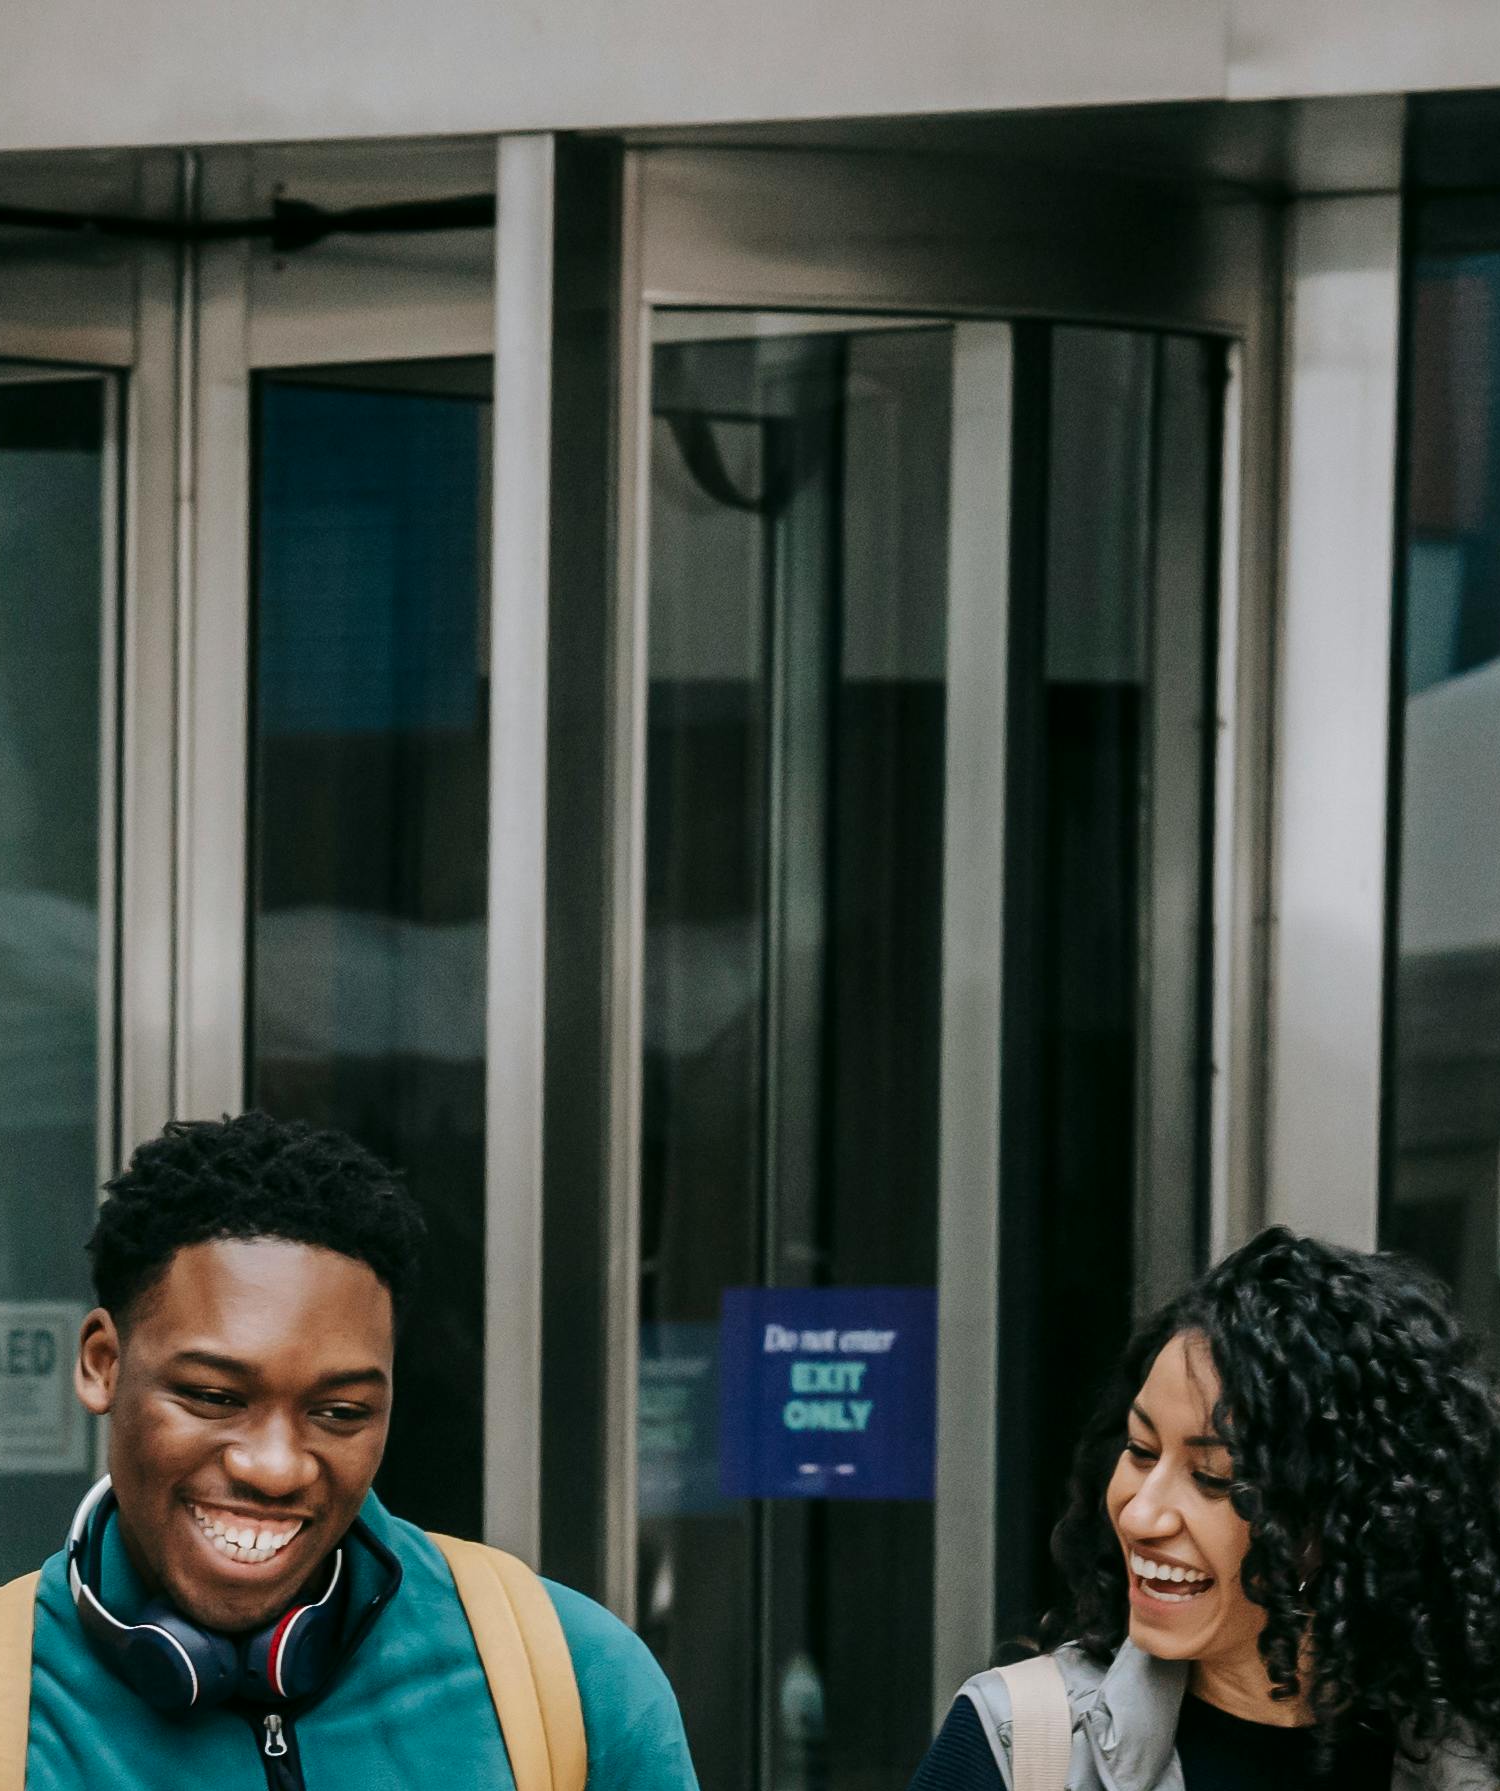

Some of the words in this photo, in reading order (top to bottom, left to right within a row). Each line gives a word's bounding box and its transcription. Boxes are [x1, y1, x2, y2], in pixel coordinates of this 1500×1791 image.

[764, 1323, 797, 1353] Do
[799, 1329, 836, 1353] not
[838, 1329, 897, 1353] enter
[791, 1361, 867, 1394] EXIT
[783, 1399, 873, 1431] ONLY
